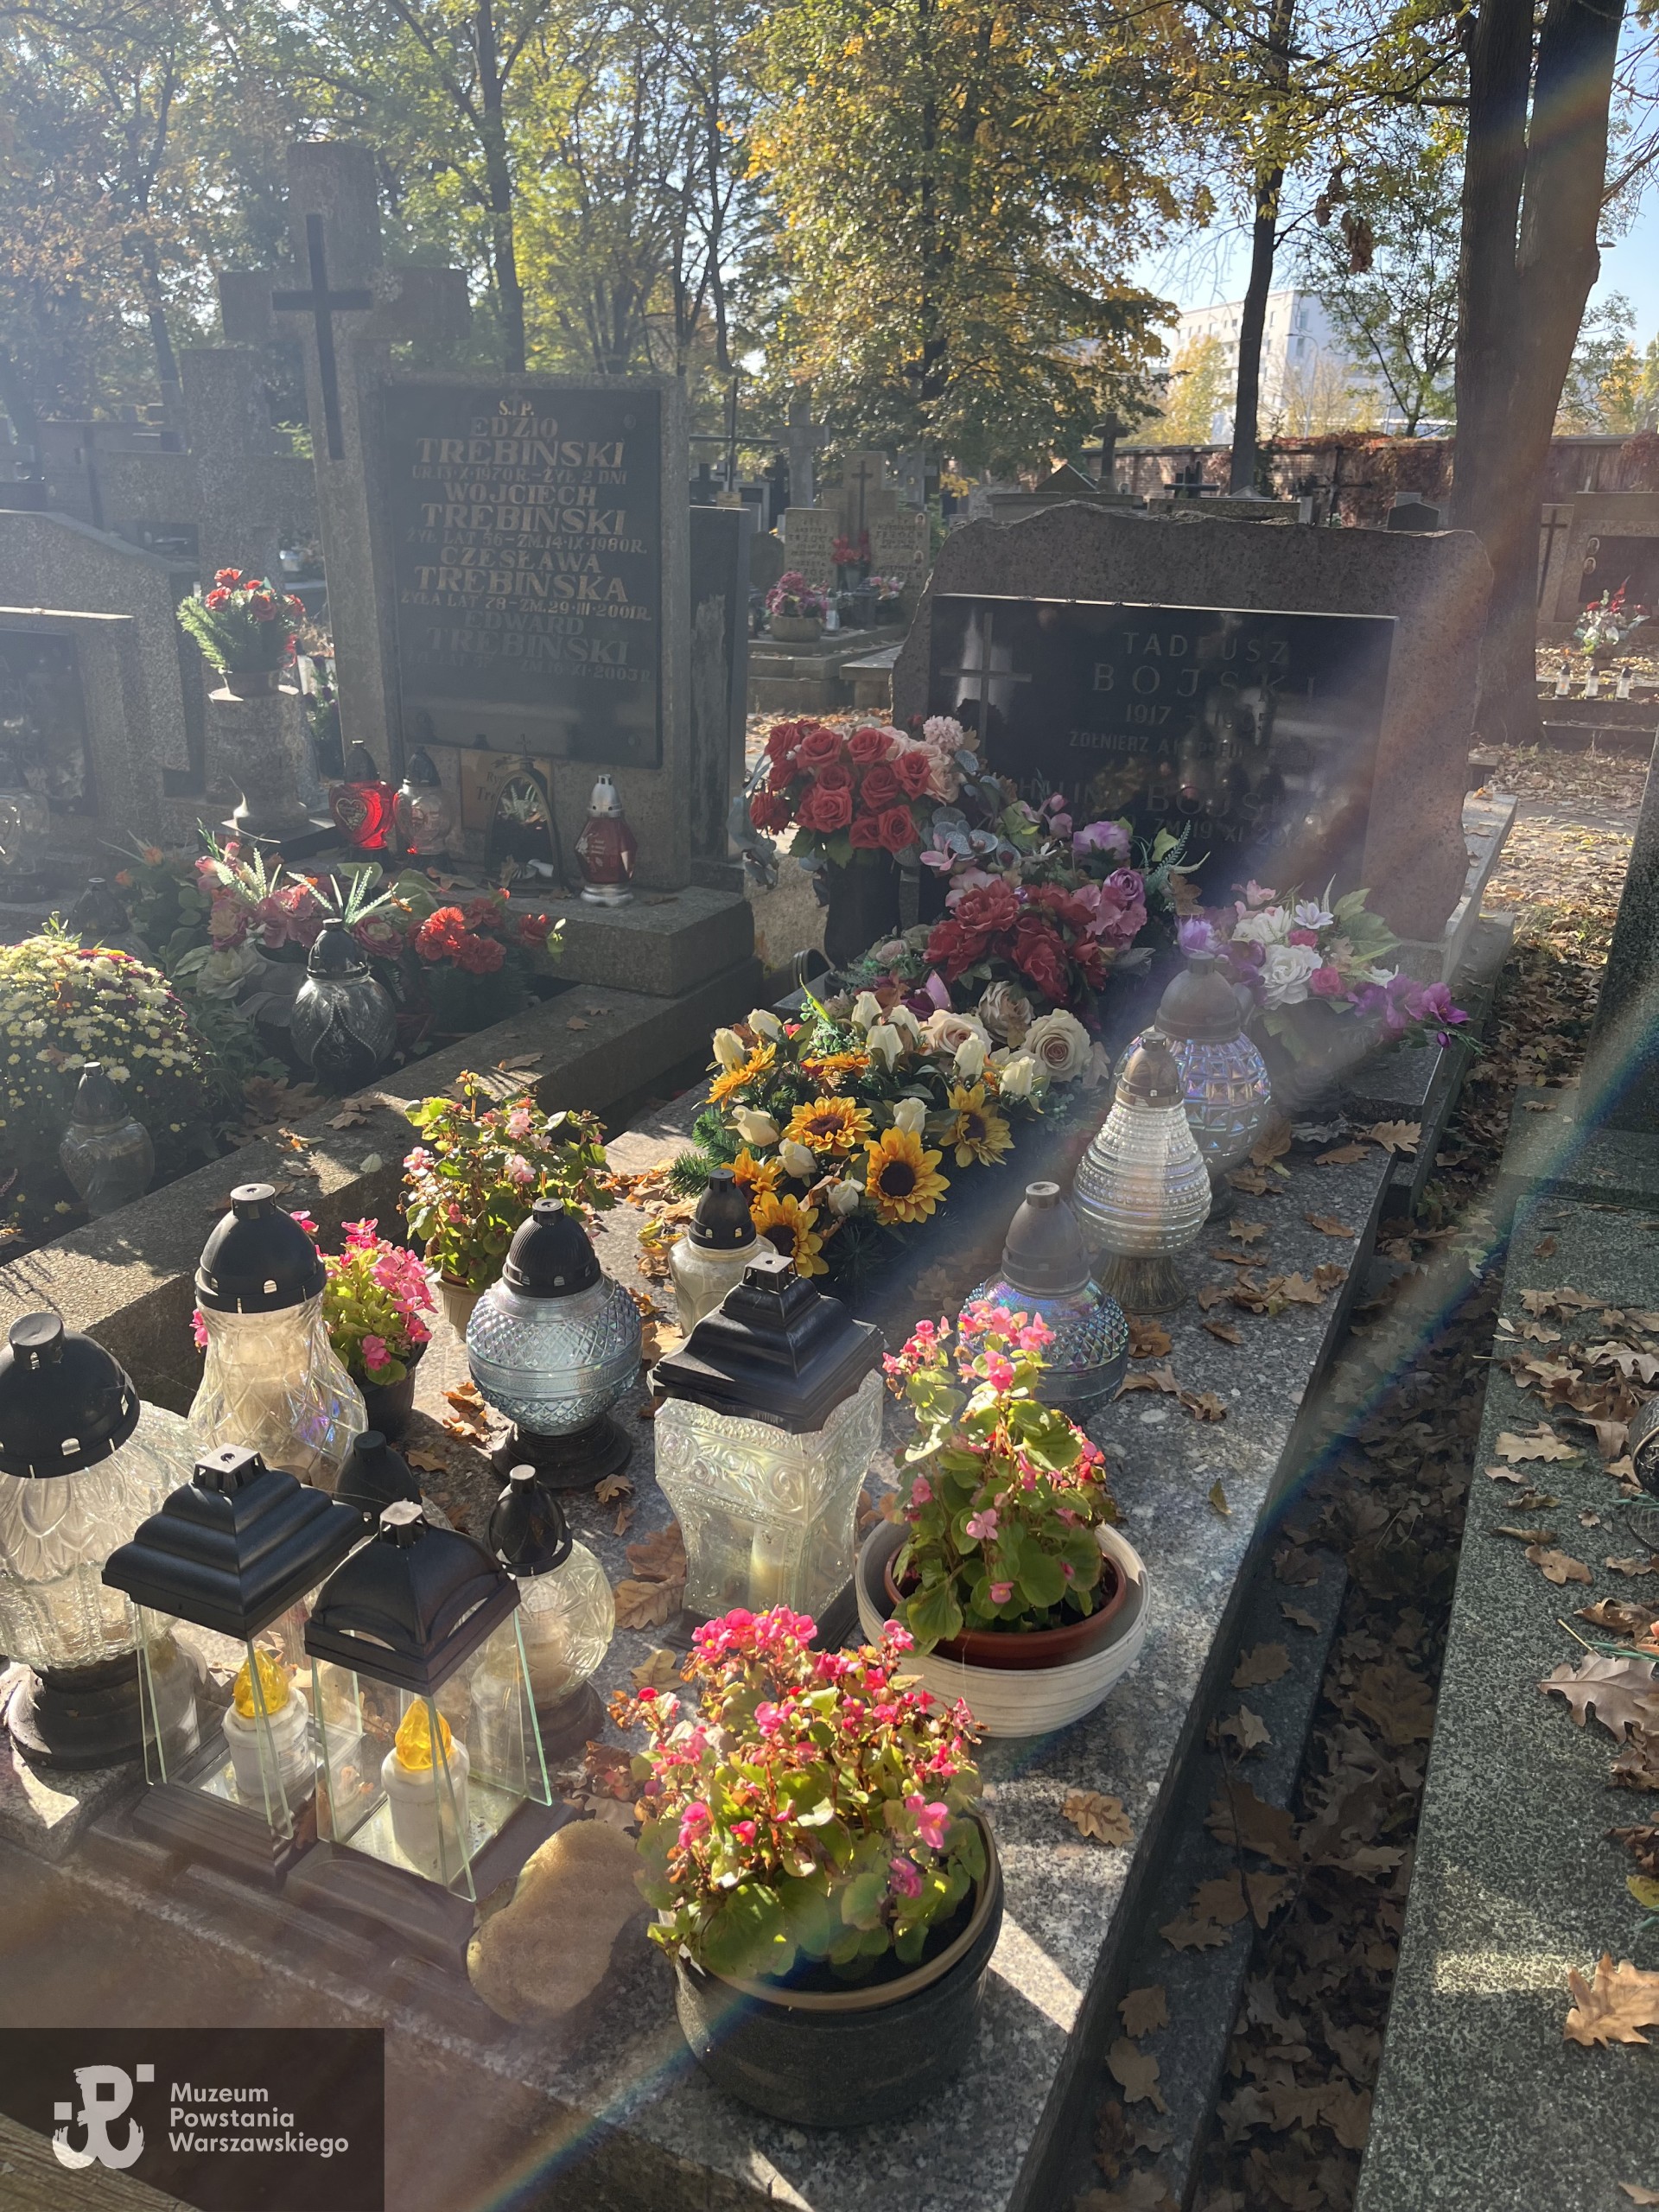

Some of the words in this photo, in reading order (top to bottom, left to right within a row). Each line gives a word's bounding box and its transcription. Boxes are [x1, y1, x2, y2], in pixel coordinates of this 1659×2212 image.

[469, 416, 558, 438] EDZIO
[416, 437, 626, 468] TRĘBIŃSKI
[582, 472, 593, 484] 2
[598, 472, 627, 485] DNI
[443, 482, 598, 506] WOJCIECH
[421, 502, 628, 536] TRĘBIŃSKI
[442, 531, 476, 545] LAT
[483, 532, 503, 548] 56
[440, 546, 601, 574] CZESŁAWA
[447, 593, 479, 608] LAT
[485, 597, 506, 611] 78
[464, 610, 584, 635] EDWARD
[1122, 632, 1289, 665] TADEUSZ
[1092, 662, 1316, 702] BOJSKI
[1125, 702, 1172, 726] 1917
